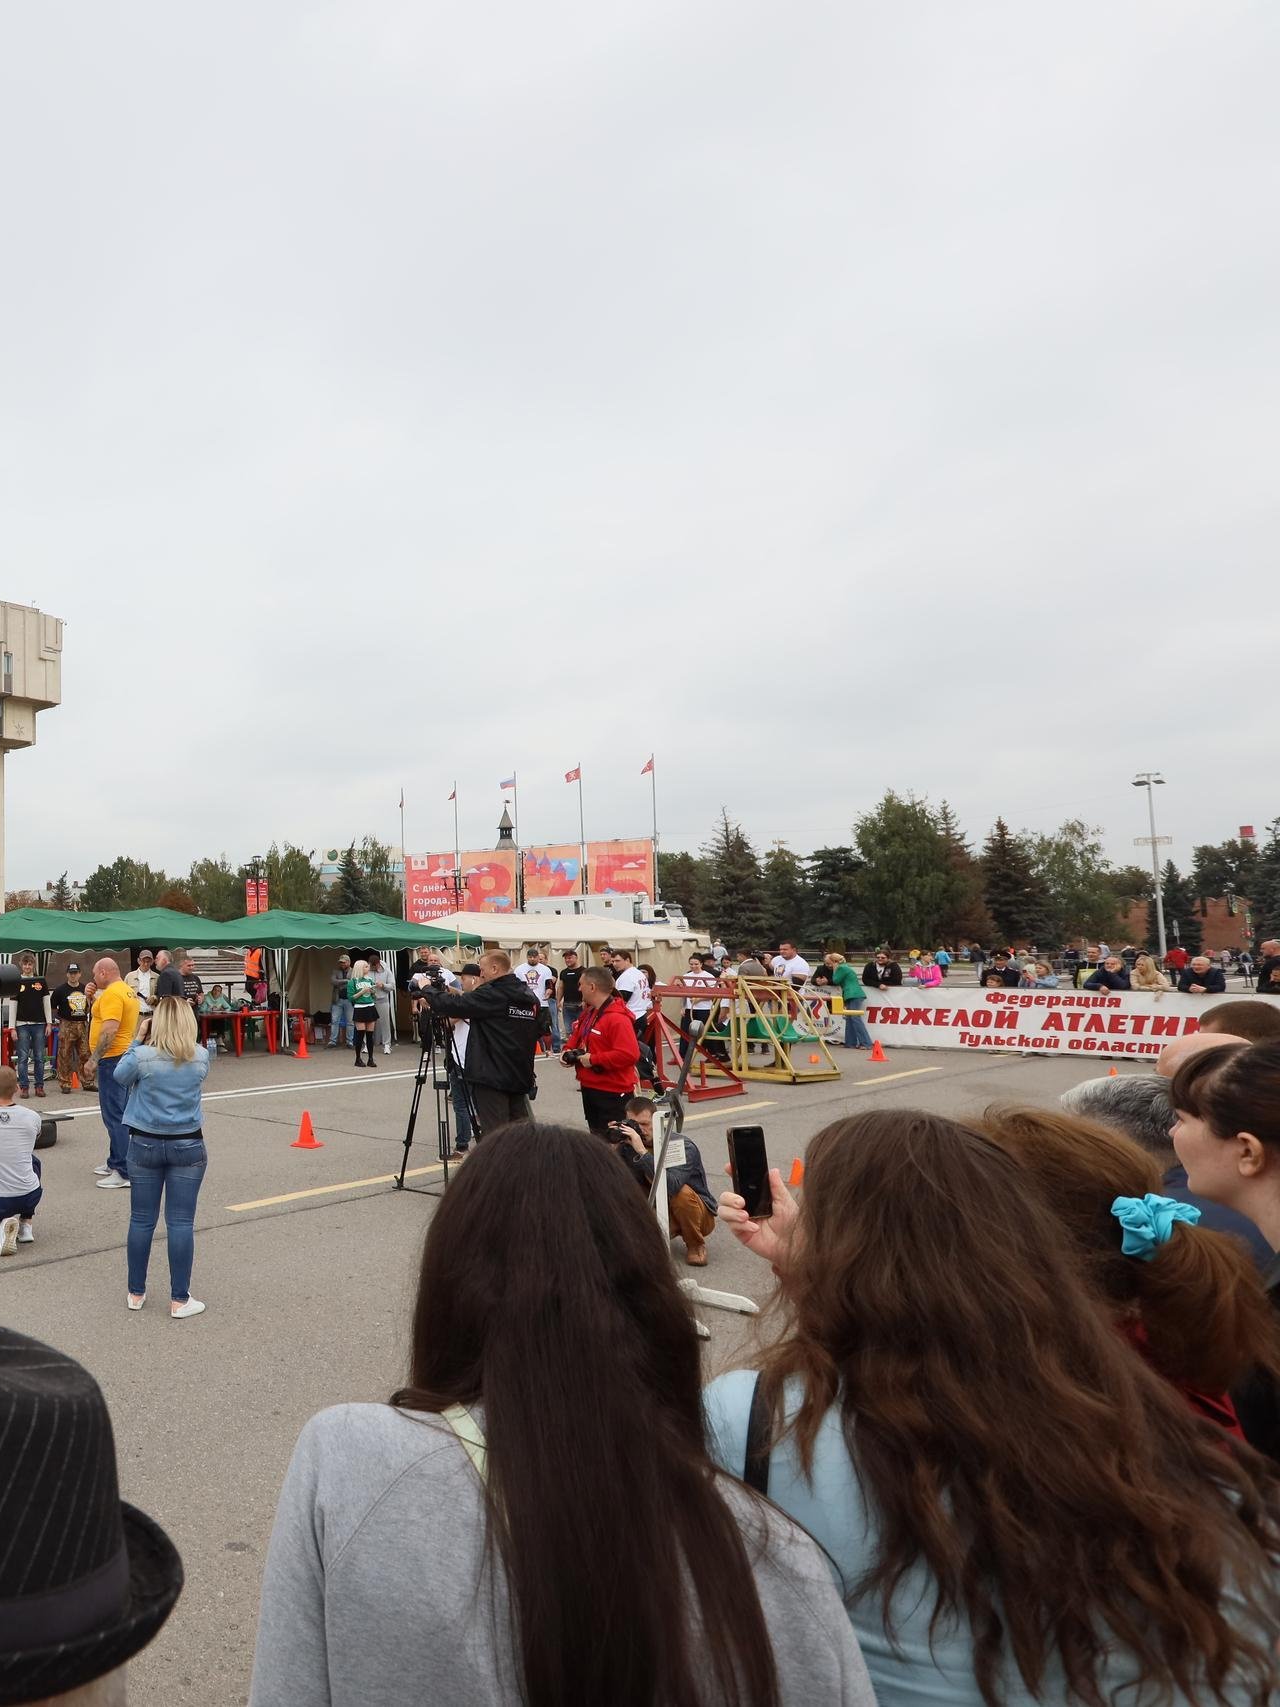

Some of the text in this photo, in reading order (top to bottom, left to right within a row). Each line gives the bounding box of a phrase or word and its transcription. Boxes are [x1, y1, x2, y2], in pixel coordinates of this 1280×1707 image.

[413, 897, 451, 906] города,
[413, 908, 451, 919] туляки!
[986, 992, 1122, 1009] Федерация
[866, 1005, 1022, 1031] ТЯЖЕЛОЙ
[958, 1031, 1060, 1050] Тульской
